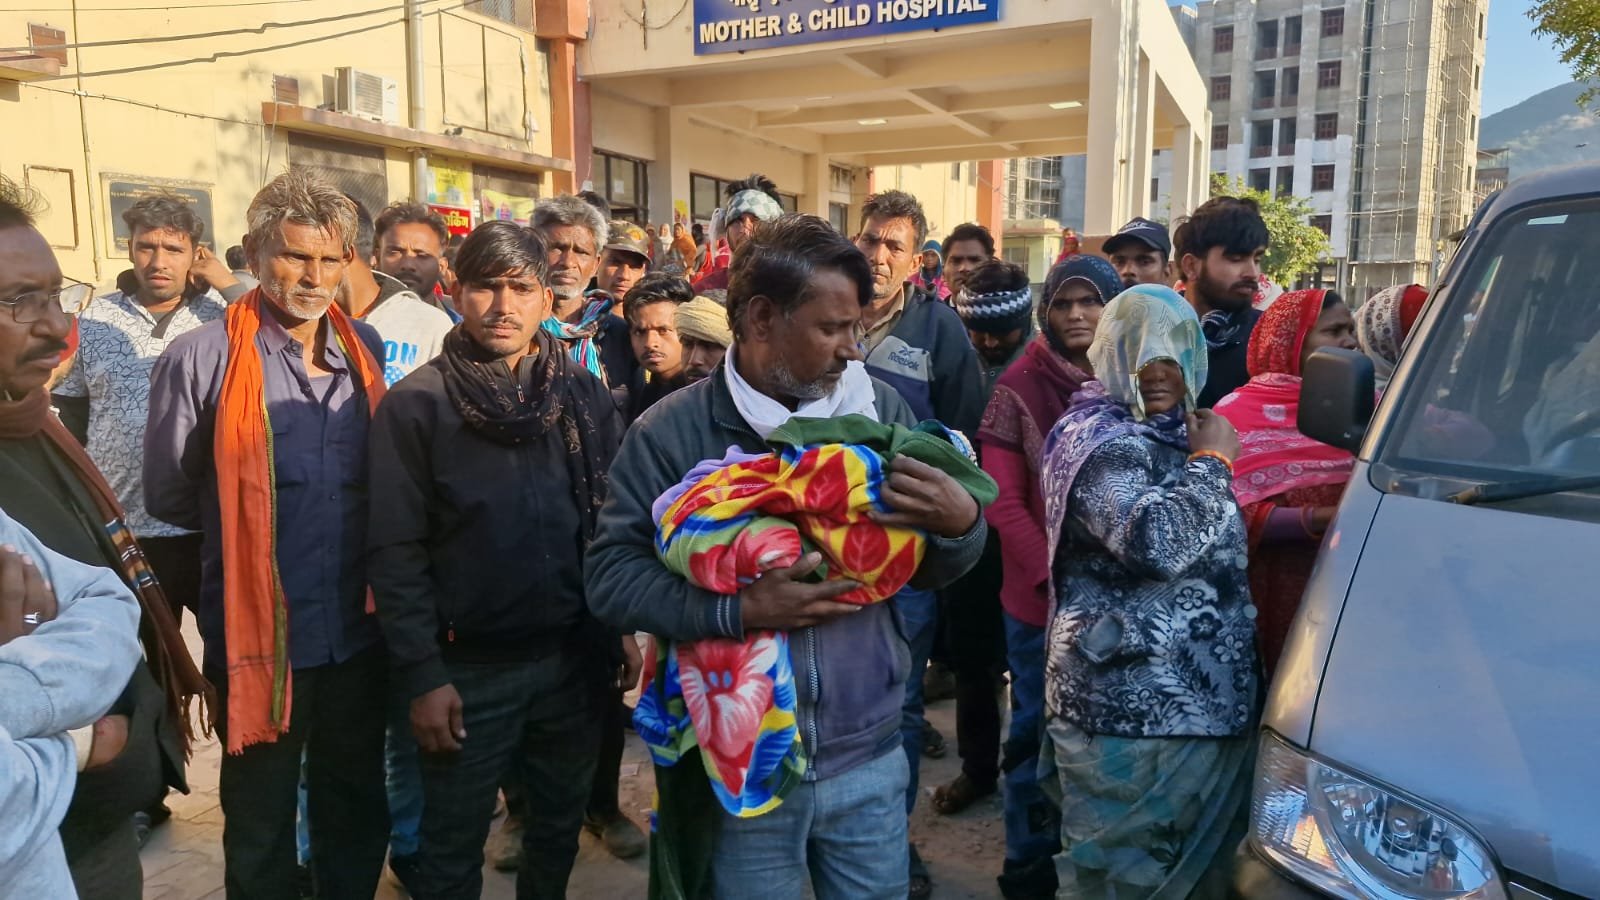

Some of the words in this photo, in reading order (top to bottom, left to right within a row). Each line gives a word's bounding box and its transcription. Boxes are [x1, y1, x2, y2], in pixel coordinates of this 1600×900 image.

[699, 15, 782, 44] MOTHER
[787, 12, 803, 35] &
[808, 4, 871, 31] CHILD
